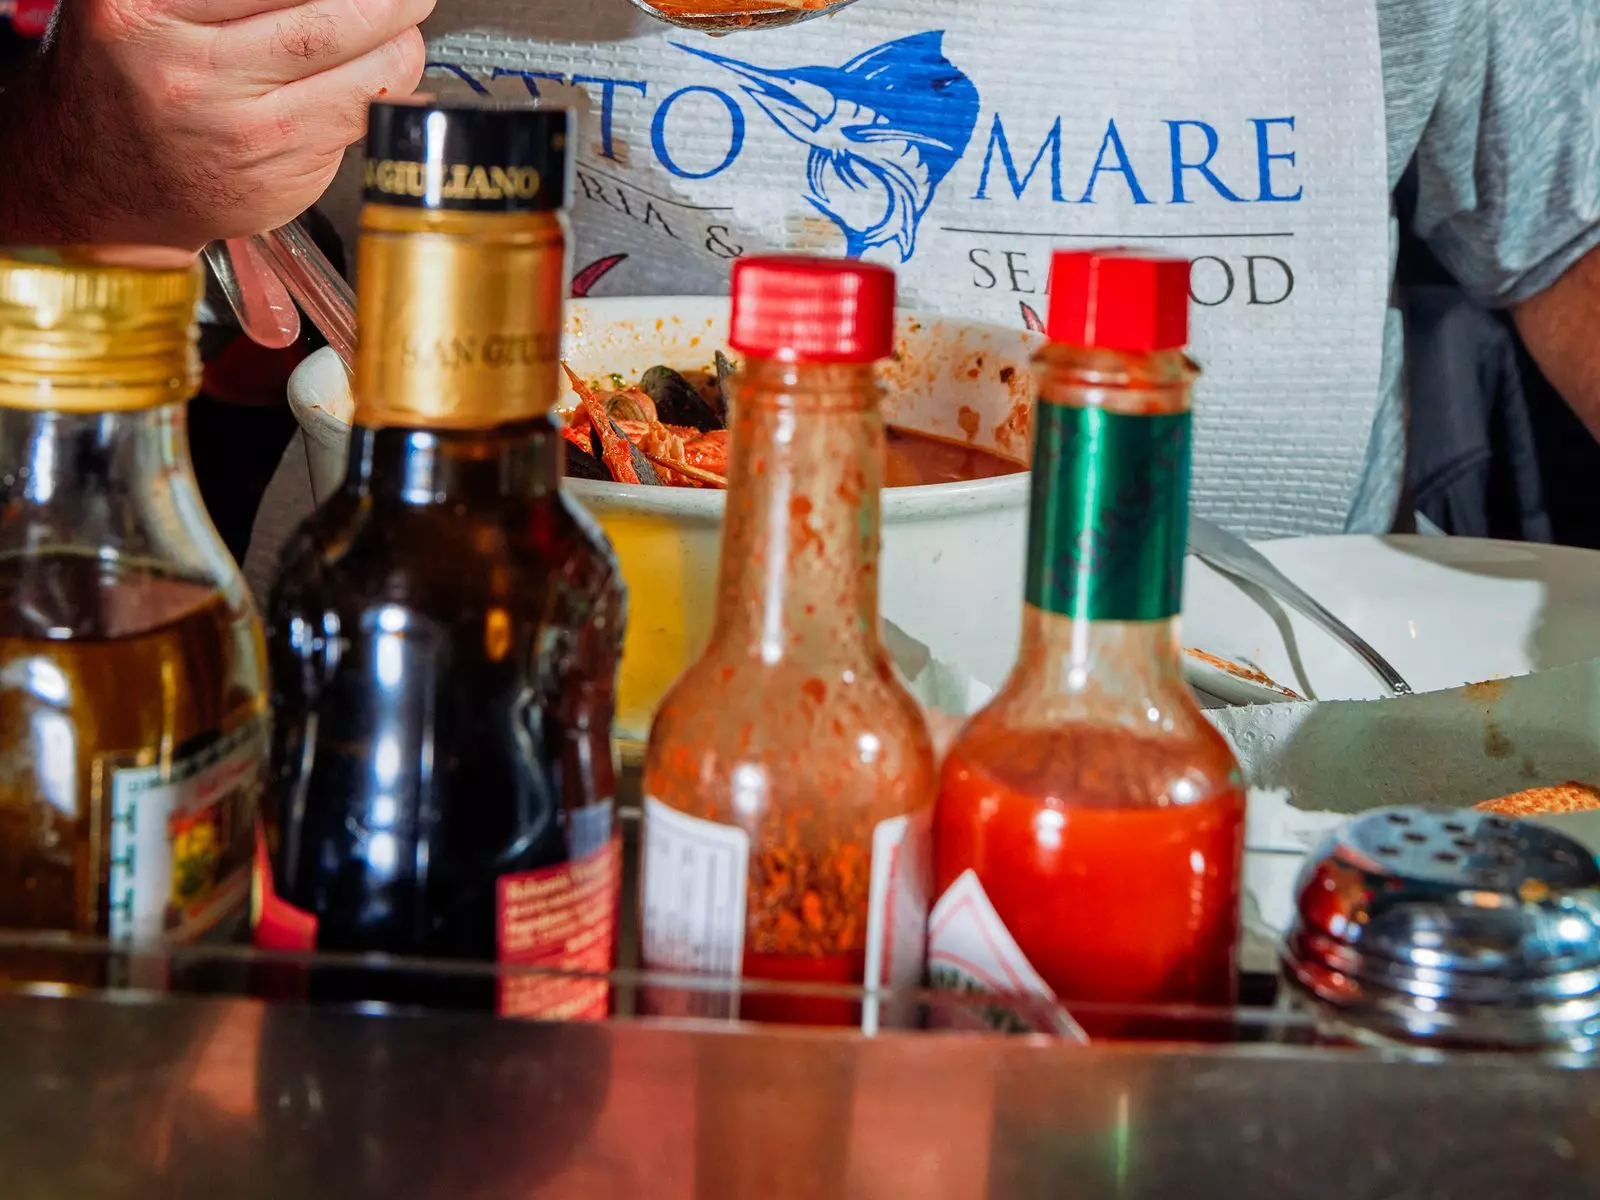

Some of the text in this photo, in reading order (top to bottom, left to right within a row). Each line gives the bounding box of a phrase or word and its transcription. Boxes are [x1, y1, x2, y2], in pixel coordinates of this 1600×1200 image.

[969, 111, 1303, 205] MARE
[705, 225, 744, 259] &
[968, 248, 1295, 307] SEOD
